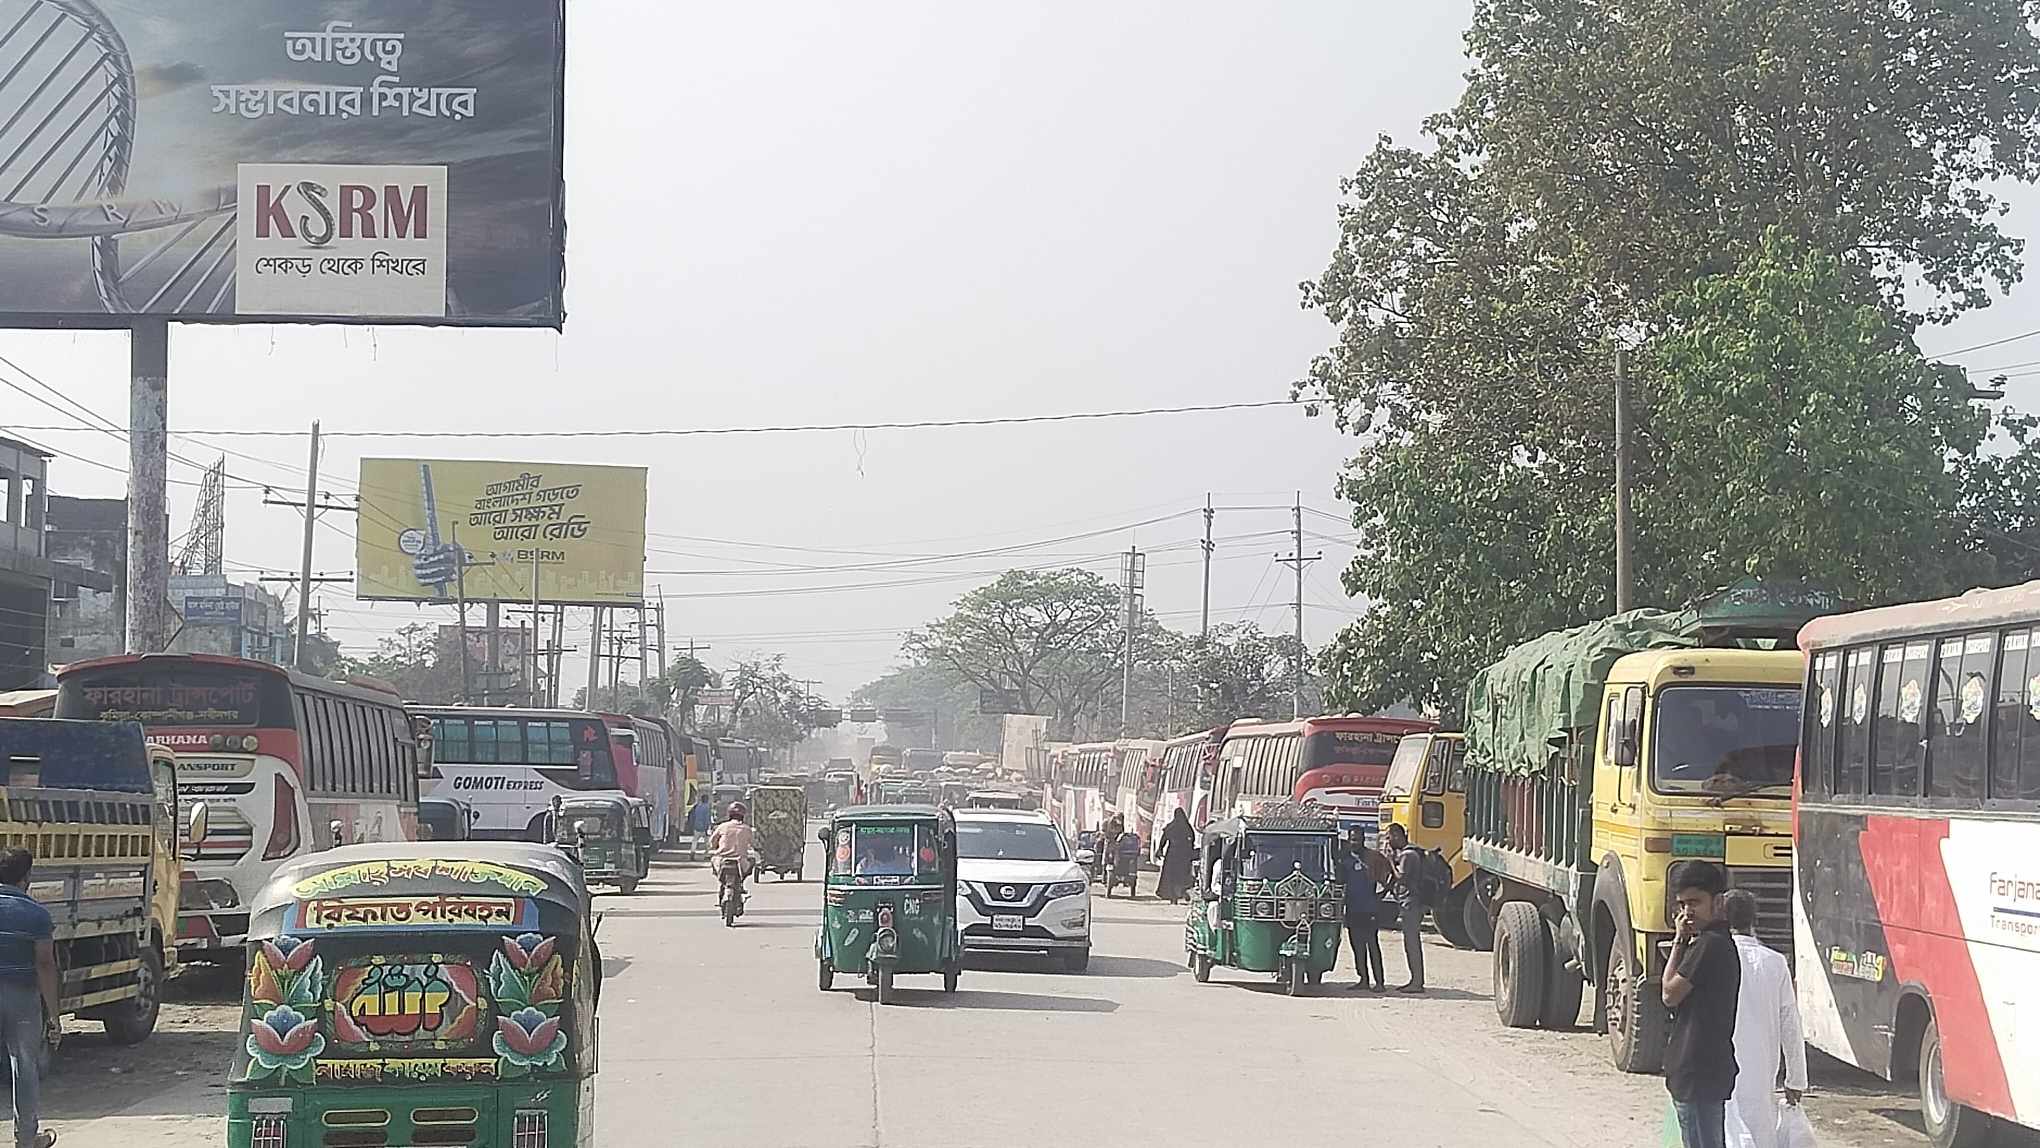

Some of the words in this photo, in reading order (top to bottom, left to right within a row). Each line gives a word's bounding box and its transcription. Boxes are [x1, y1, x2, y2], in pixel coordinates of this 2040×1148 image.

[284, 21, 404, 72] অস্তিত্বে
[210, 84, 363, 120] সম্ভাবনার
[369, 75, 477, 120] শিখরে
[256, 181, 429, 245] KSRM
[255, 257, 313, 278] শেকড়
[319, 257, 365, 276] থেকে
[371, 251, 427, 277] শিখরে
[474, 492, 533, 511] বাংলাদেশ
[535, 484, 583, 502] গড়তে
[486, 472, 542, 496] আগামীর
[469, 510, 509, 527] আরো
[511, 503, 565, 523] সক্ষম
[493, 524, 540, 542] আরো
[542, 515, 591, 541] রেডি
[146, 734, 208, 745] ARHANA
[453, 776, 506, 791] GOMOTI
[506, 779, 545, 791] EXPRESS
